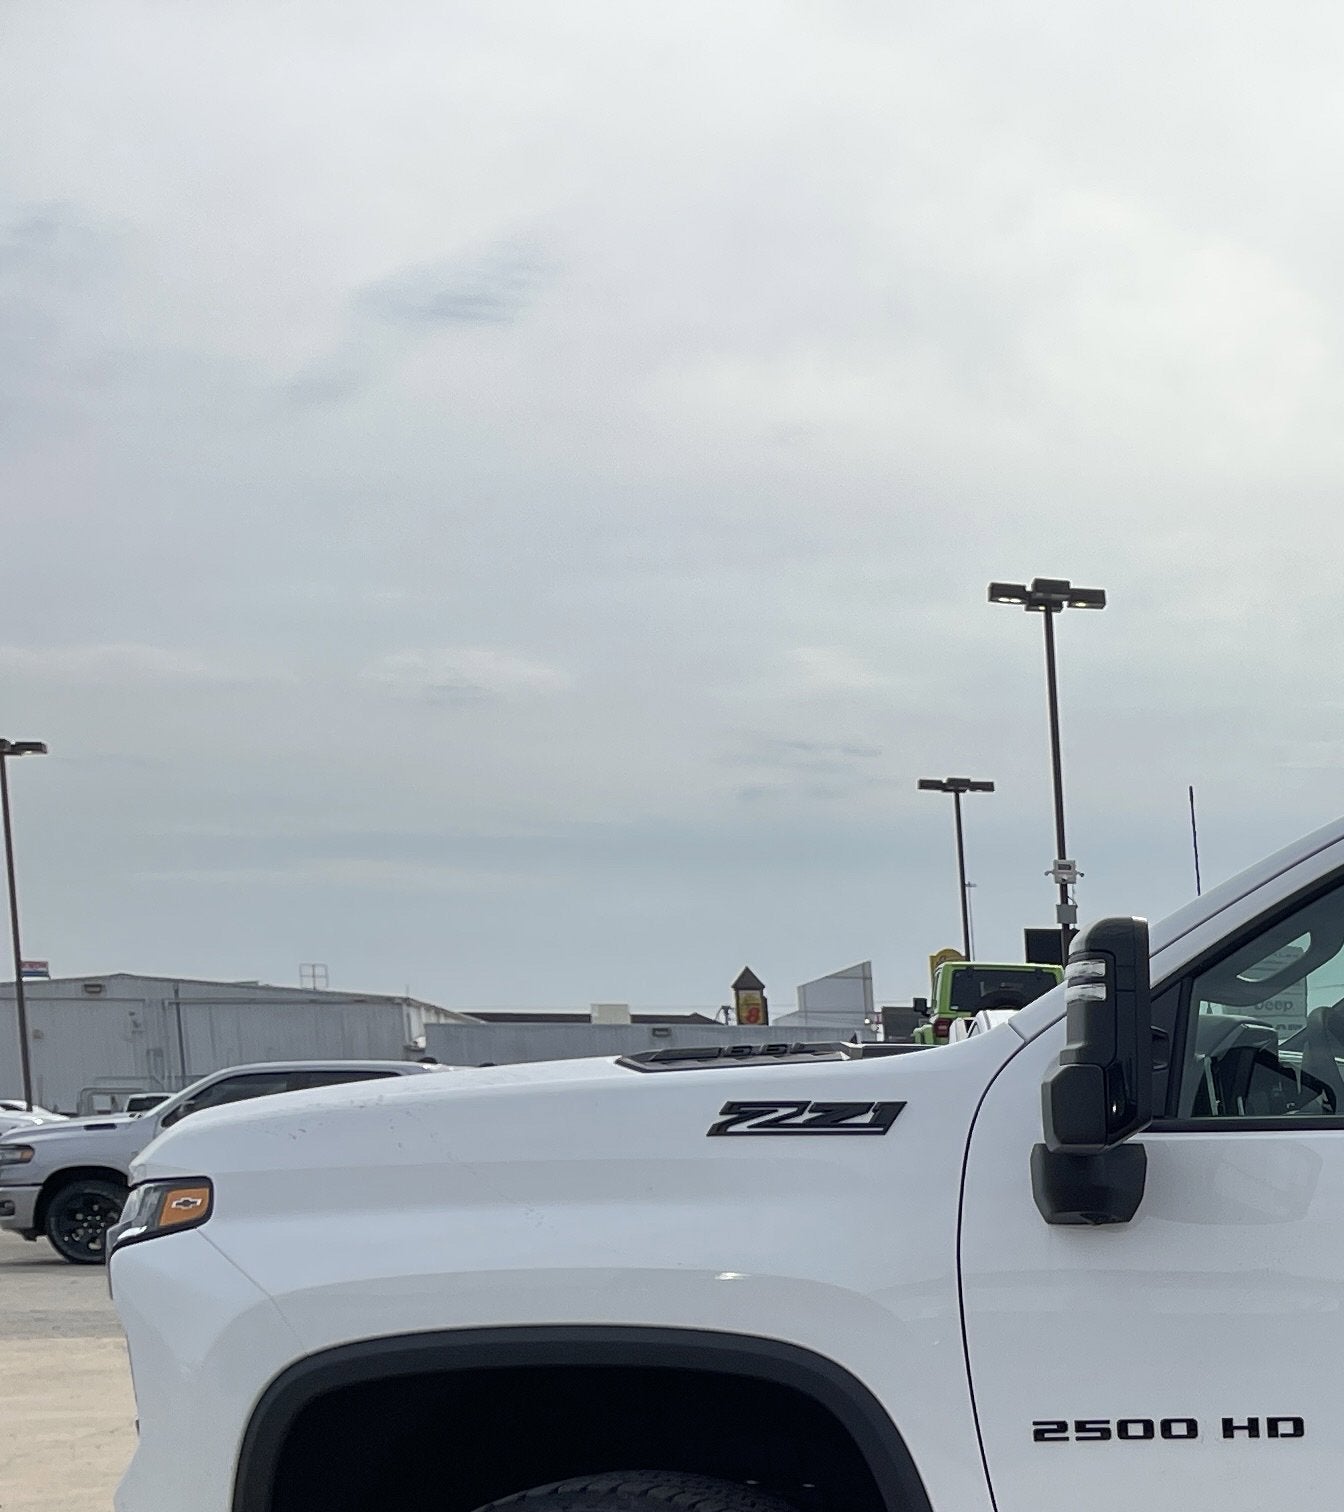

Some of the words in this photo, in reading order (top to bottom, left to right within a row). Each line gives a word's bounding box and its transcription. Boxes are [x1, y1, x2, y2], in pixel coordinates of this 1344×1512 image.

[706, 1100, 908, 1137] Z71
[1032, 1417, 1199, 1442] 2500
[1221, 1416, 1305, 1439] HD
